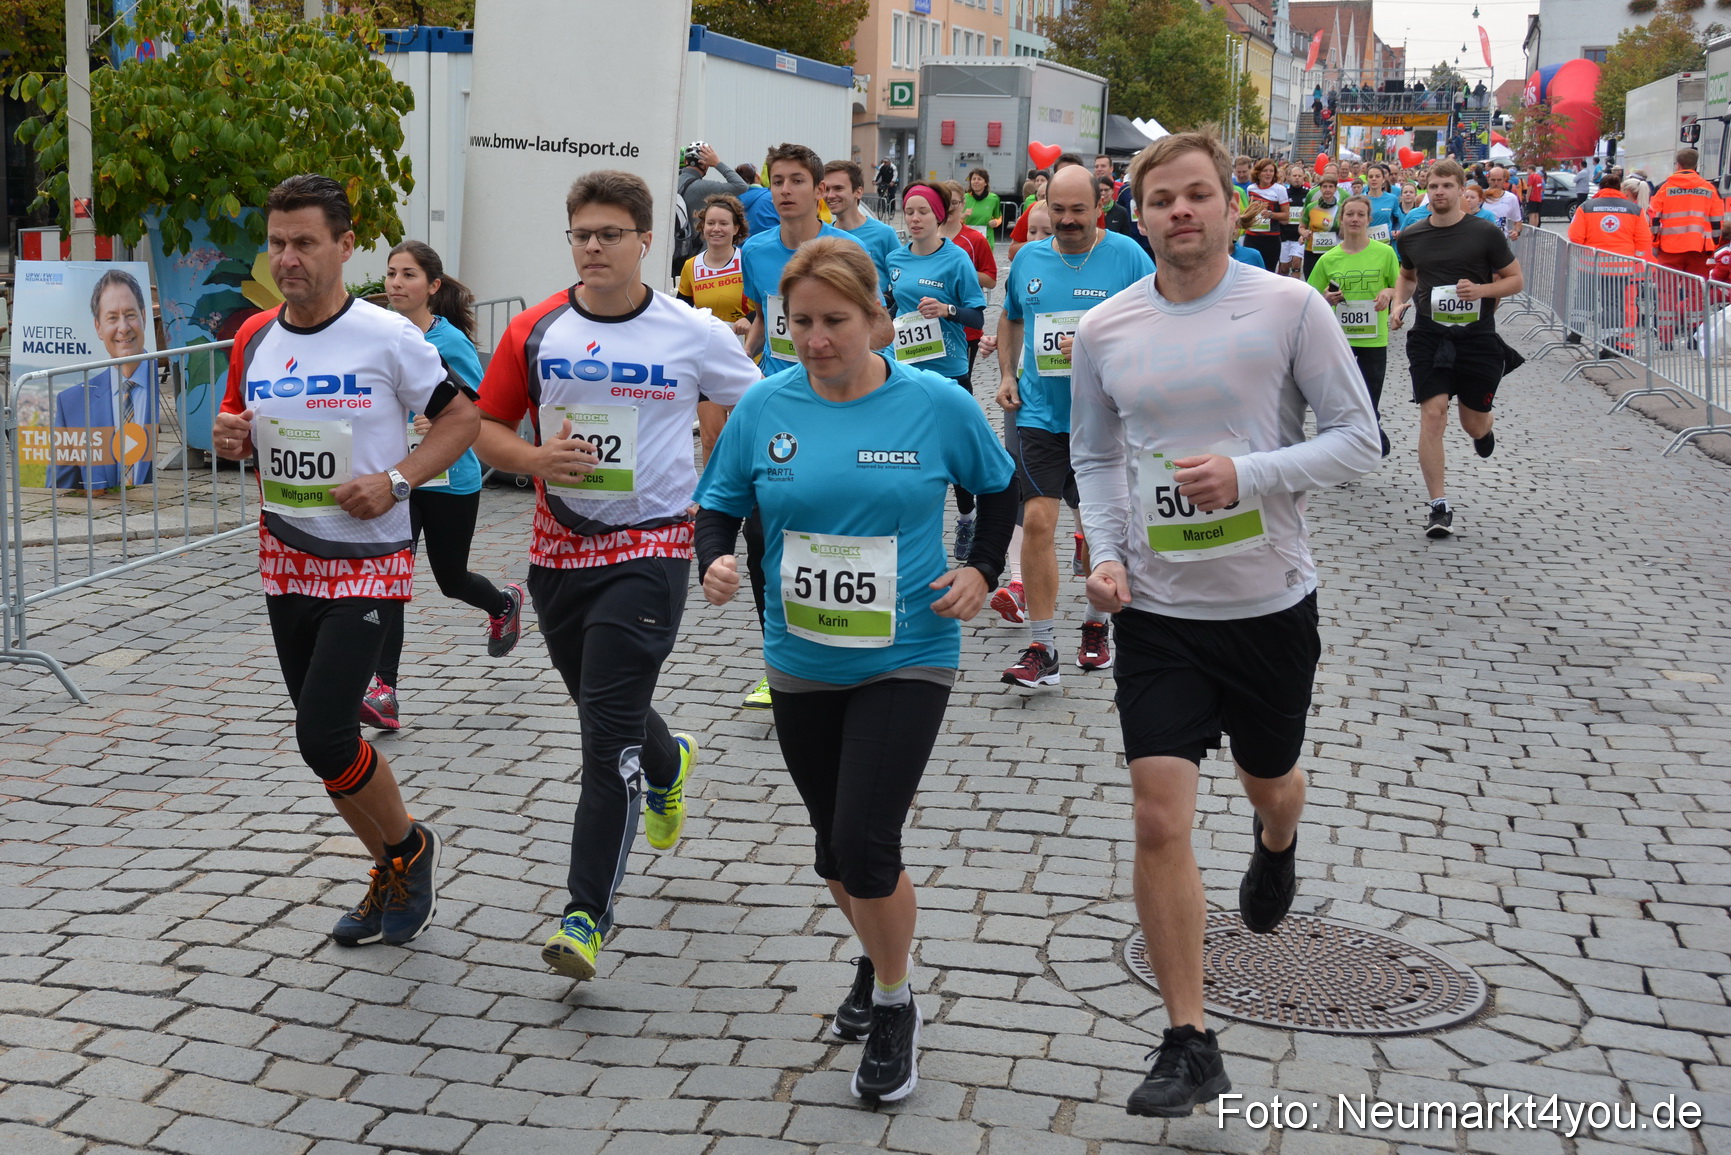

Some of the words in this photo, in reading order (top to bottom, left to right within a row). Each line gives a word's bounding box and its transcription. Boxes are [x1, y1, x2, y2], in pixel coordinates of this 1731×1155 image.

[893, 85, 911, 103] D
[1382, 115, 1406, 125] ZIEL
[469, 133, 640, 158] www.bmw-laufsport.de
[1669, 187, 1709, 196] NOTARZT
[1316, 238, 1333, 246] 5223
[694, 282, 715, 292] MAX
[918, 278, 945, 289] BOCK
[1073, 288, 1109, 298] BOCK
[1438, 299, 1474, 312] 5046
[1341, 312, 1369, 324] 5081
[22, 325, 77, 340] WEITER.
[898, 324, 932, 345] 5131
[22, 341, 92, 355] MACHEN.
[905, 344, 933, 356] Magdalena
[610, 384, 676, 401] energie
[306, 393, 372, 409] energie
[575, 413, 608, 422] BOCK
[21, 430, 103, 447] THOMAS
[286, 429, 321, 439] BOCK
[270, 447, 336, 480] 5050
[858, 450, 919, 464] BOCK
[767, 467, 795, 476] PARTL
[280, 487, 323, 503] Wolfgang
[579, 530, 633, 552] AVIA
[1182, 525, 1224, 542] Marcel
[820, 545, 861, 556] BOCK
[303, 558, 355, 577] AVIA
[359, 553, 412, 576] AVIA
[286, 576, 332, 599] AVIA
[334, 575, 387, 598] AVIA
[794, 566, 876, 605] 5165
[363, 615, 380, 625] adidas
[818, 613, 848, 628] Karin
